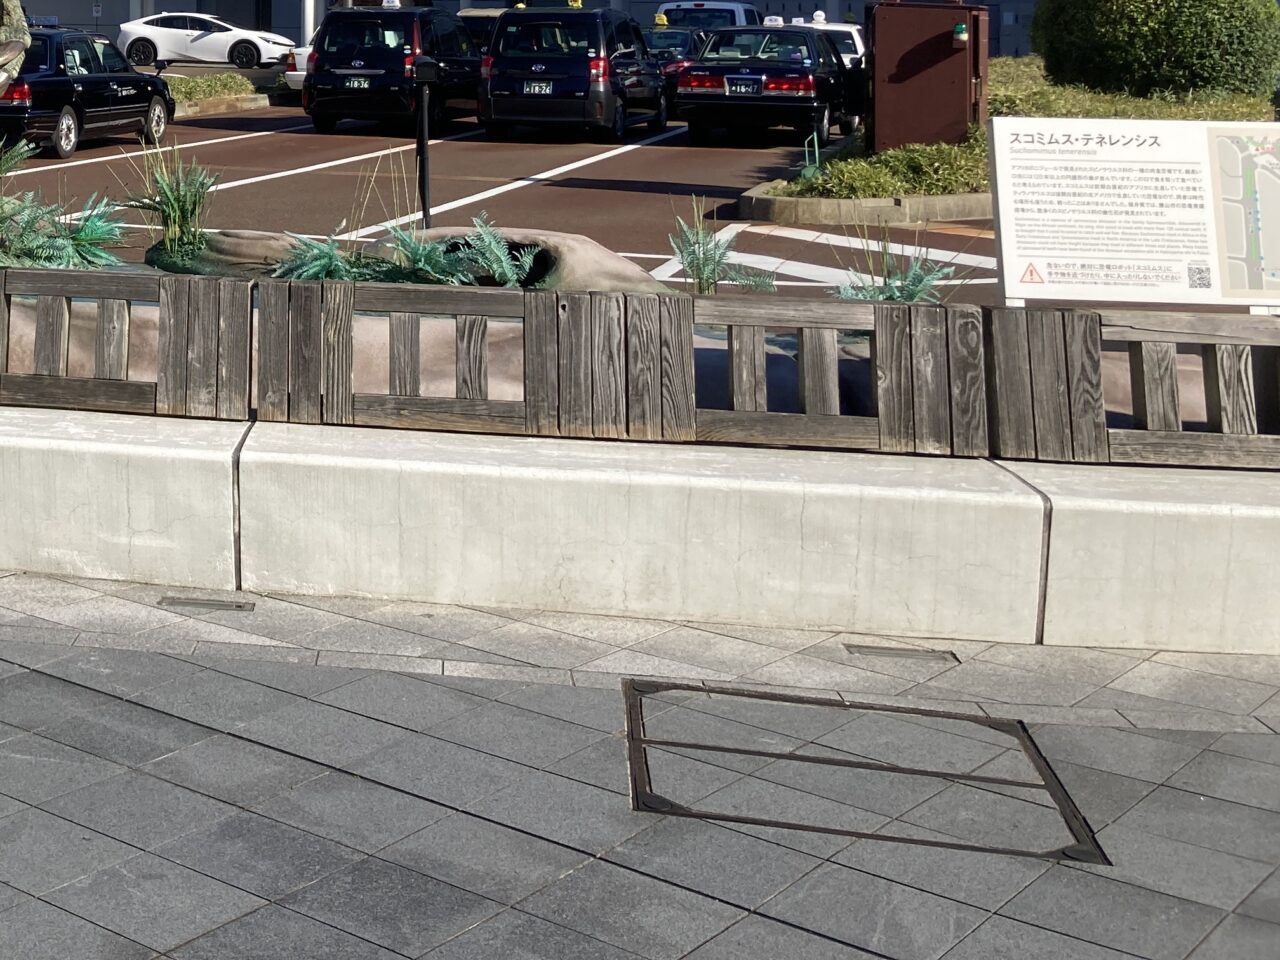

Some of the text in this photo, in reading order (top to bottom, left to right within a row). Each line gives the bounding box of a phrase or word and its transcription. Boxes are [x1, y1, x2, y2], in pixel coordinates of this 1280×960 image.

[1010, 132, 1161, 147] スコミムス・テネレンシス
